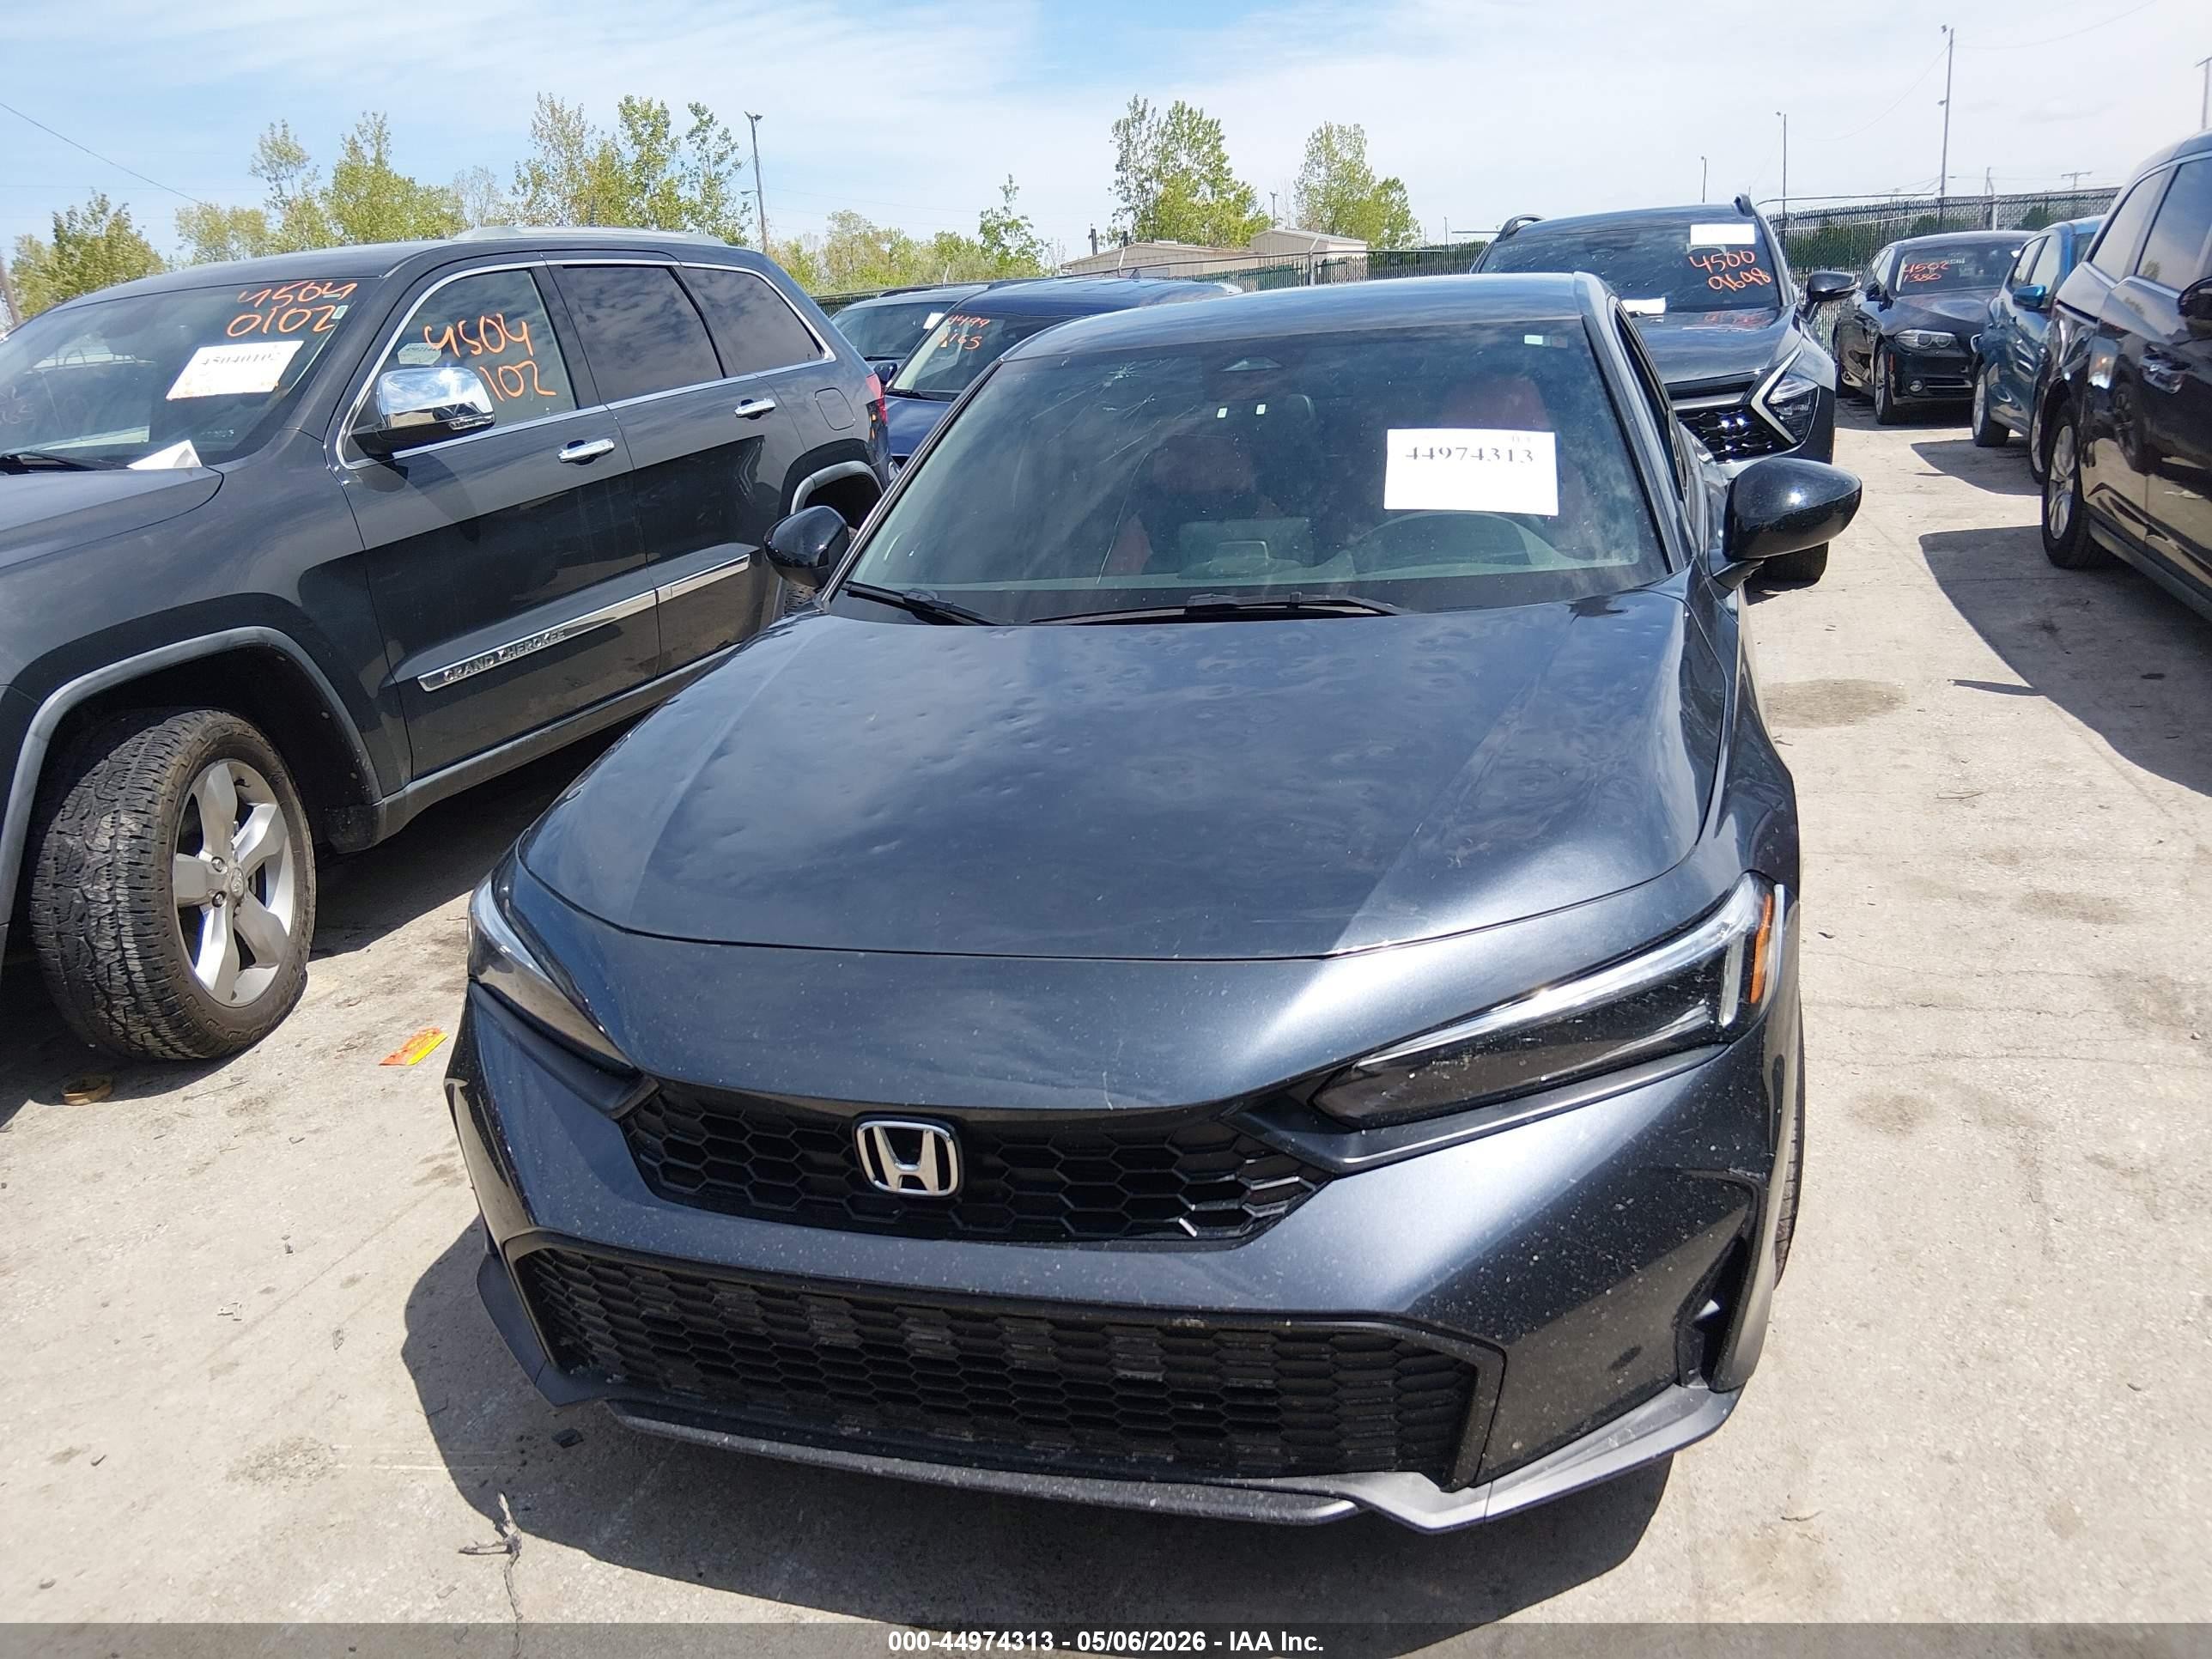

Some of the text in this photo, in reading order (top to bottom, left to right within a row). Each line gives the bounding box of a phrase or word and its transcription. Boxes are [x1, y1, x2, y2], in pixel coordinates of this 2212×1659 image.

[1688, 250, 1755, 273] 4500
[237, 280, 358, 307] 4504
[227, 305, 337, 337] 0102
[423, 313, 534, 359] 4504
[478, 360, 557, 403] 102
[1405, 446, 1534, 465] 44974313
[442, 627, 567, 683] GRAND CHEROKEE
